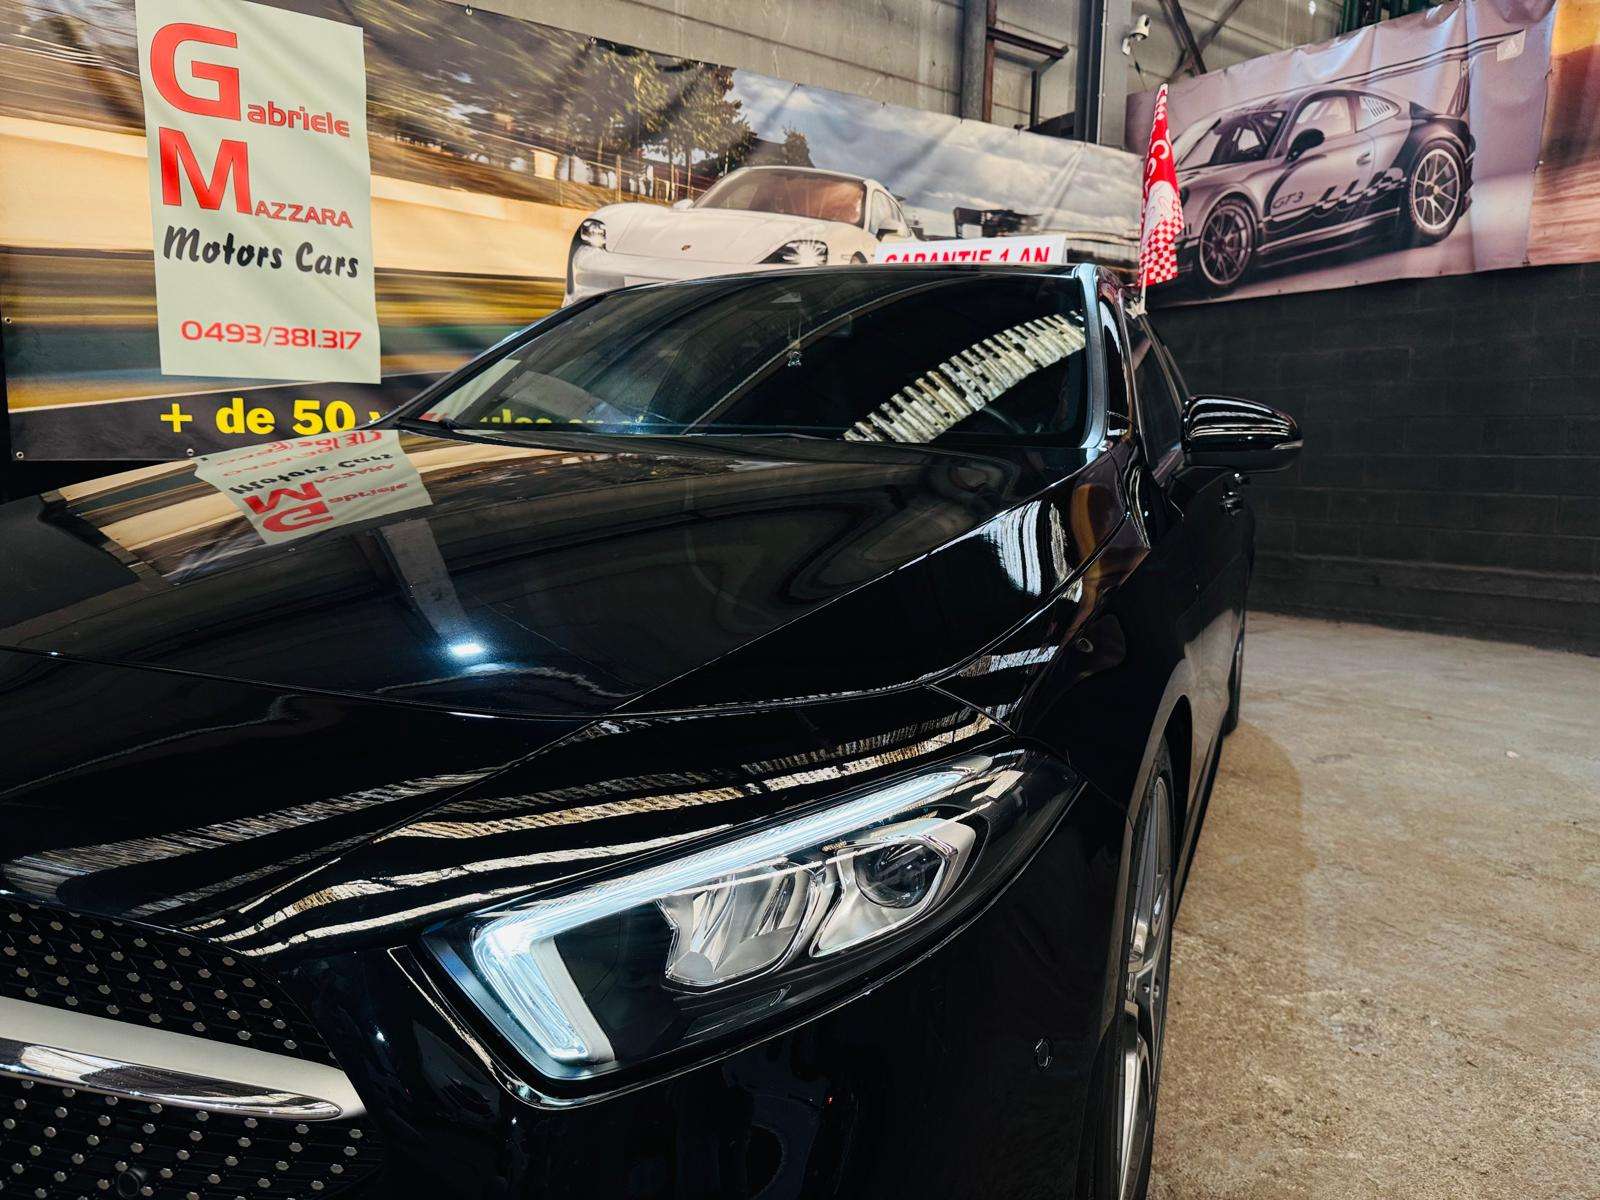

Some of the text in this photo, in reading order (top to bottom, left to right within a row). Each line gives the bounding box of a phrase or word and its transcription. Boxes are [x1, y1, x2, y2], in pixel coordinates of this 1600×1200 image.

[150, 22, 351, 138] Gabriele
[159, 126, 353, 228] MAZZARA
[163, 225, 359, 279] Motors Cars
[1020, 246, 1050, 263] AN
[181, 319, 362, 350] 0493/381.317
[160, 397, 356, 435] + de 50
